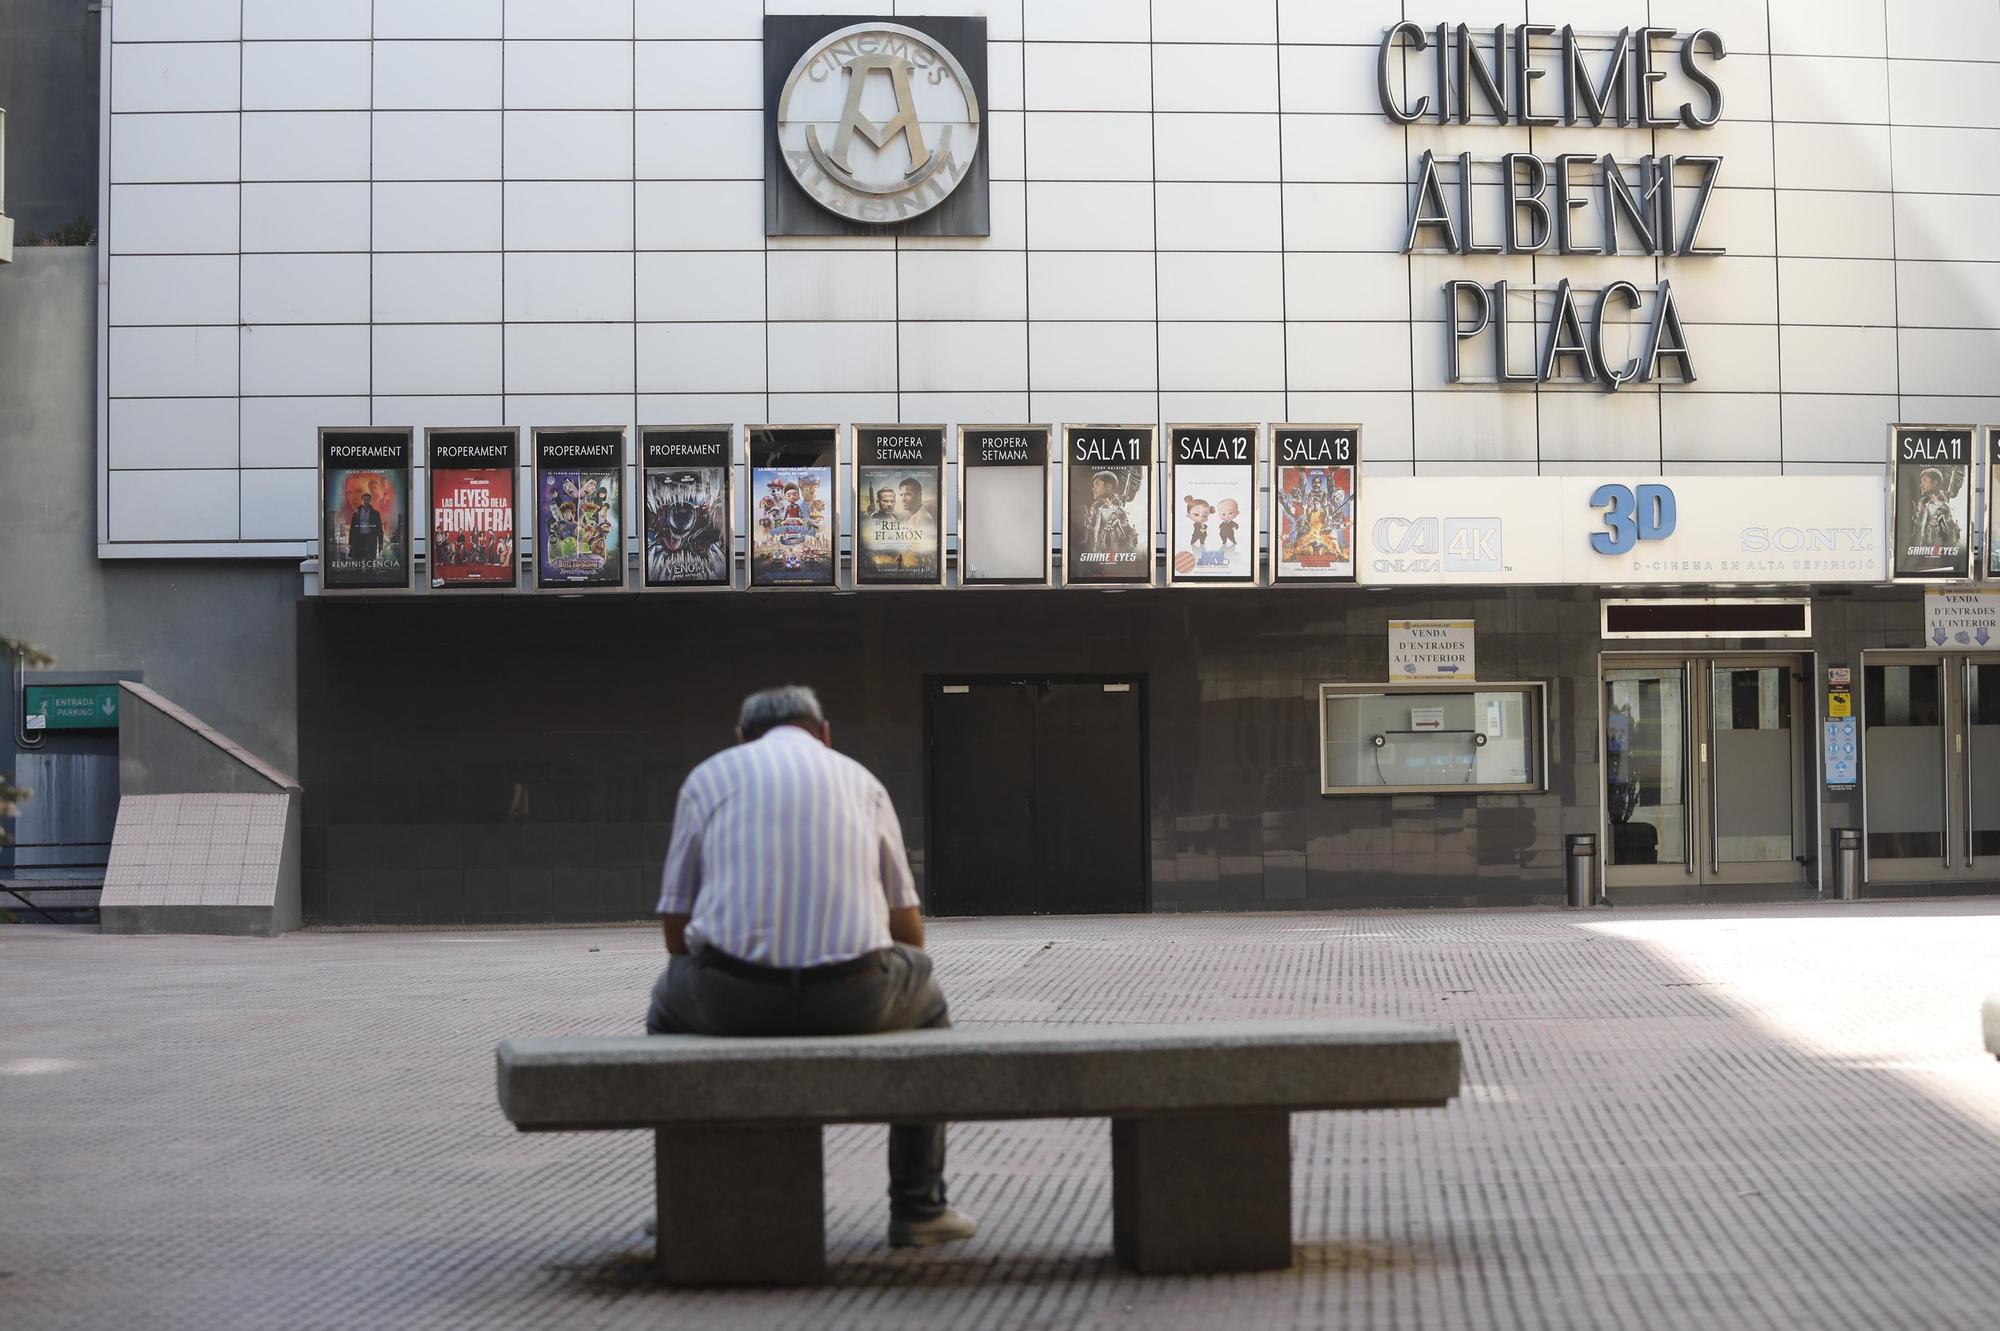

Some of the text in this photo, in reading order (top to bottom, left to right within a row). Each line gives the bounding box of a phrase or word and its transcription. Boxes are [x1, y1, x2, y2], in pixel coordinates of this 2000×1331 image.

[1376, 21, 1725, 130] CINEMES
[1445, 277, 1696, 394] PLAÇA
[876, 436, 923, 447] PROPERA
[982, 437, 1028, 448] PROPERA
[330, 446, 402, 457] PROPERAMENT
[437, 445, 509, 457] PROPERAMENT
[543, 444, 615, 456] PROPERAMENT
[650, 444, 721, 456] PROPERAMENT
[1076, 438, 1140, 461] SALA 11
[1180, 436, 1247, 460] SALA 12
[1283, 437, 1350, 461] SALA 13
[1903, 437, 1961, 460] SALA 11
[876, 449, 923, 460] SETMANA
[982, 450, 1028, 460] SETMANA
[441, 489, 507, 507] LAS LEYES DE LA
[435, 508, 512, 532] FRONTERA
[1589, 483, 1677, 556] 3D
[1447, 527, 1499, 561] 4K
[1741, 527, 1873, 552] SONY
[1080, 552, 1137, 562] SNAKE EYES
[1938, 546, 1959, 556] EYES
[331, 559, 401, 568] REMINISCENCIA
[665, 561, 705, 575] VENOM
[1633, 560, 1713, 571] D-CINEMA
[1721, 560, 1739, 570] EN
[1747, 560, 1785, 570] ALTA
[1412, 629, 1447, 637] VENDA
[1394, 655, 1400, 663] A
[57, 708, 94, 717] PARKING
